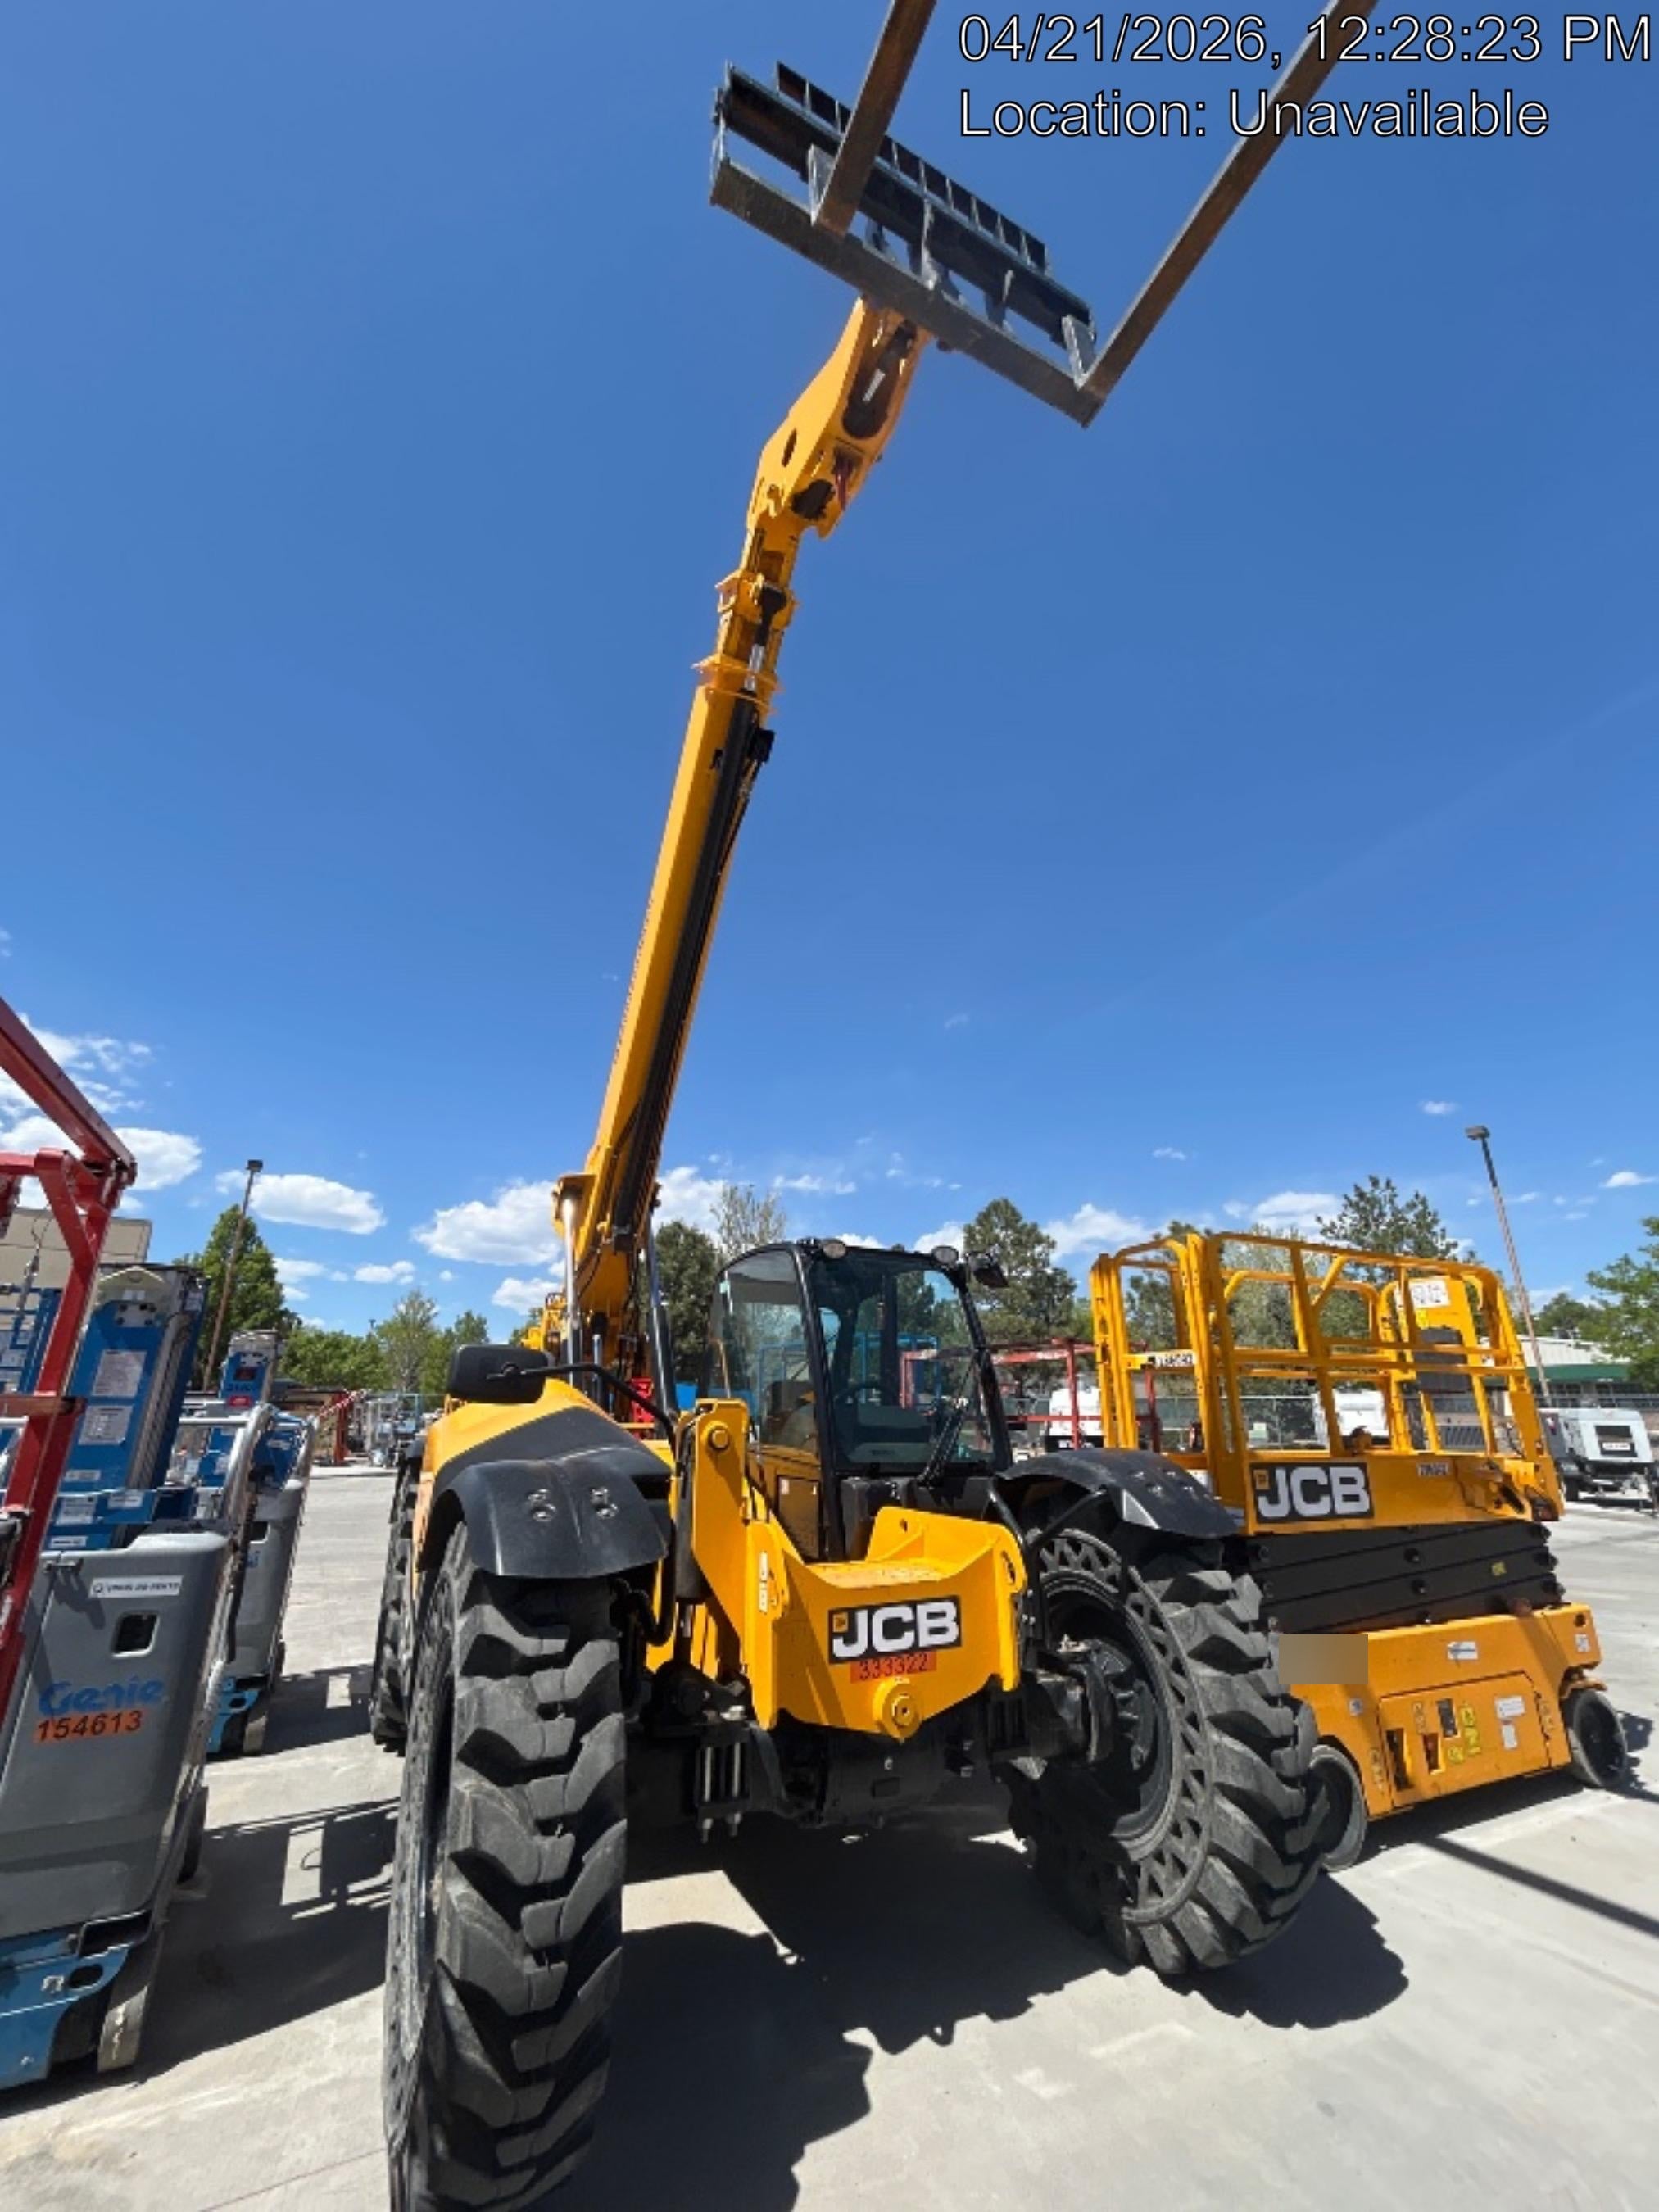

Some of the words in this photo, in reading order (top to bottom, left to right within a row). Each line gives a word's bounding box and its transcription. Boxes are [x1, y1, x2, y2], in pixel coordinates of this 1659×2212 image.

[1257, 1466, 1371, 1518] JCB
[832, 1601, 959, 1658] JCB
[859, 1651, 929, 1681] 333322
[39, 1675, 165, 1716] Genie
[38, 1709, 143, 1742] 154613
